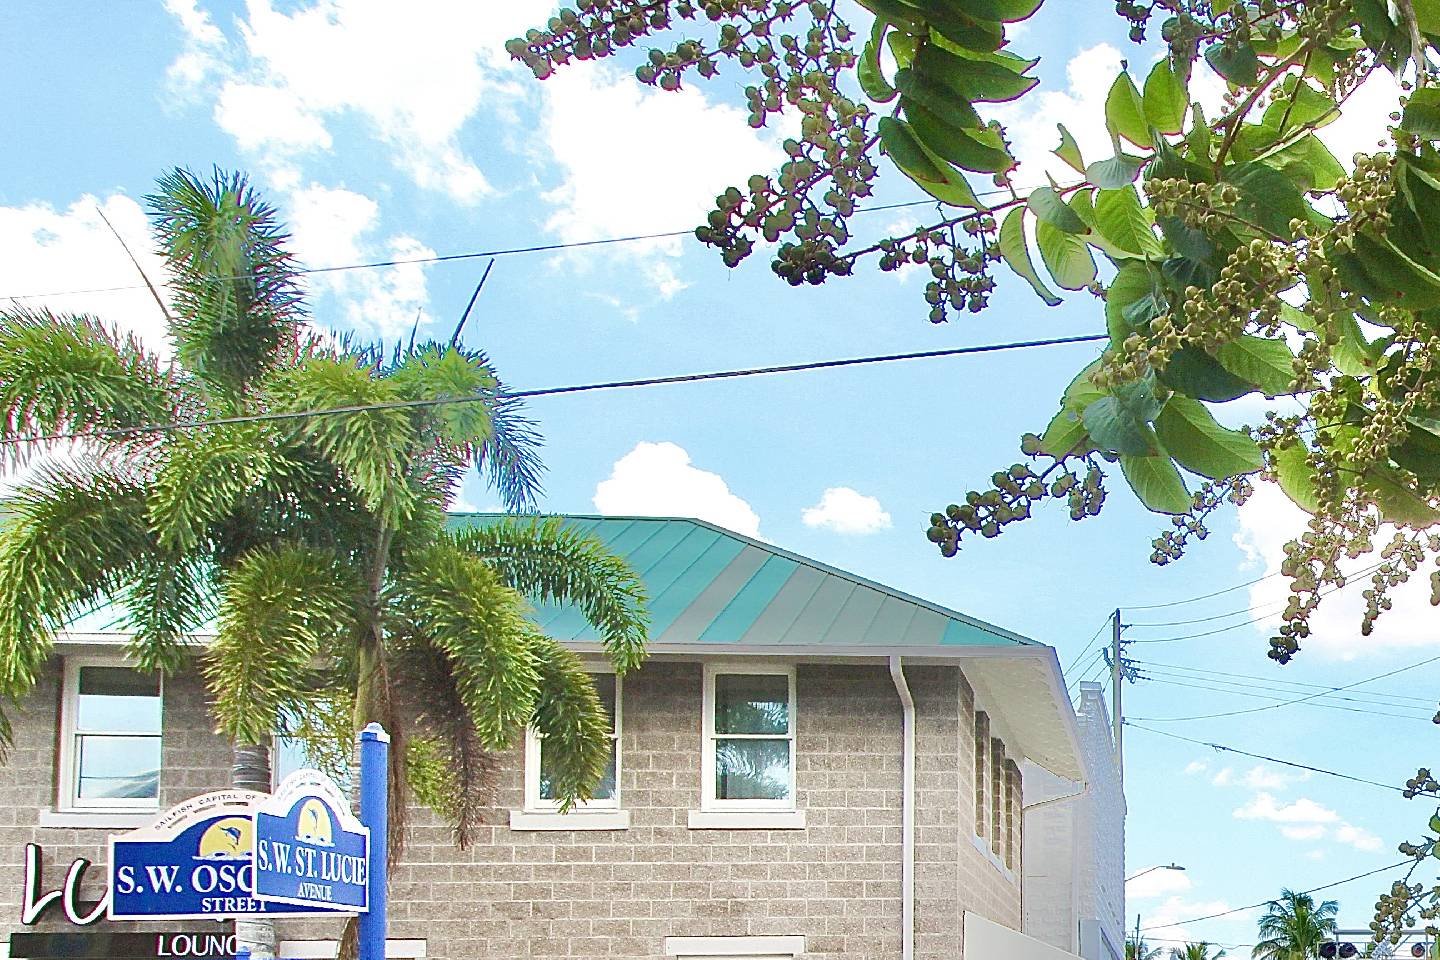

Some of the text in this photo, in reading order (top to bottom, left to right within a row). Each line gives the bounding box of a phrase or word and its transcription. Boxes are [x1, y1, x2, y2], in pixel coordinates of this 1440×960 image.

[199, 794, 239, 805] CAPITAL
[258, 840, 366, 885] S.W. ST. LUCIE
[117, 864, 182, 894] S.W.
[297, 882, 333, 901] AVENUE
[202, 897, 266, 912] STREET
